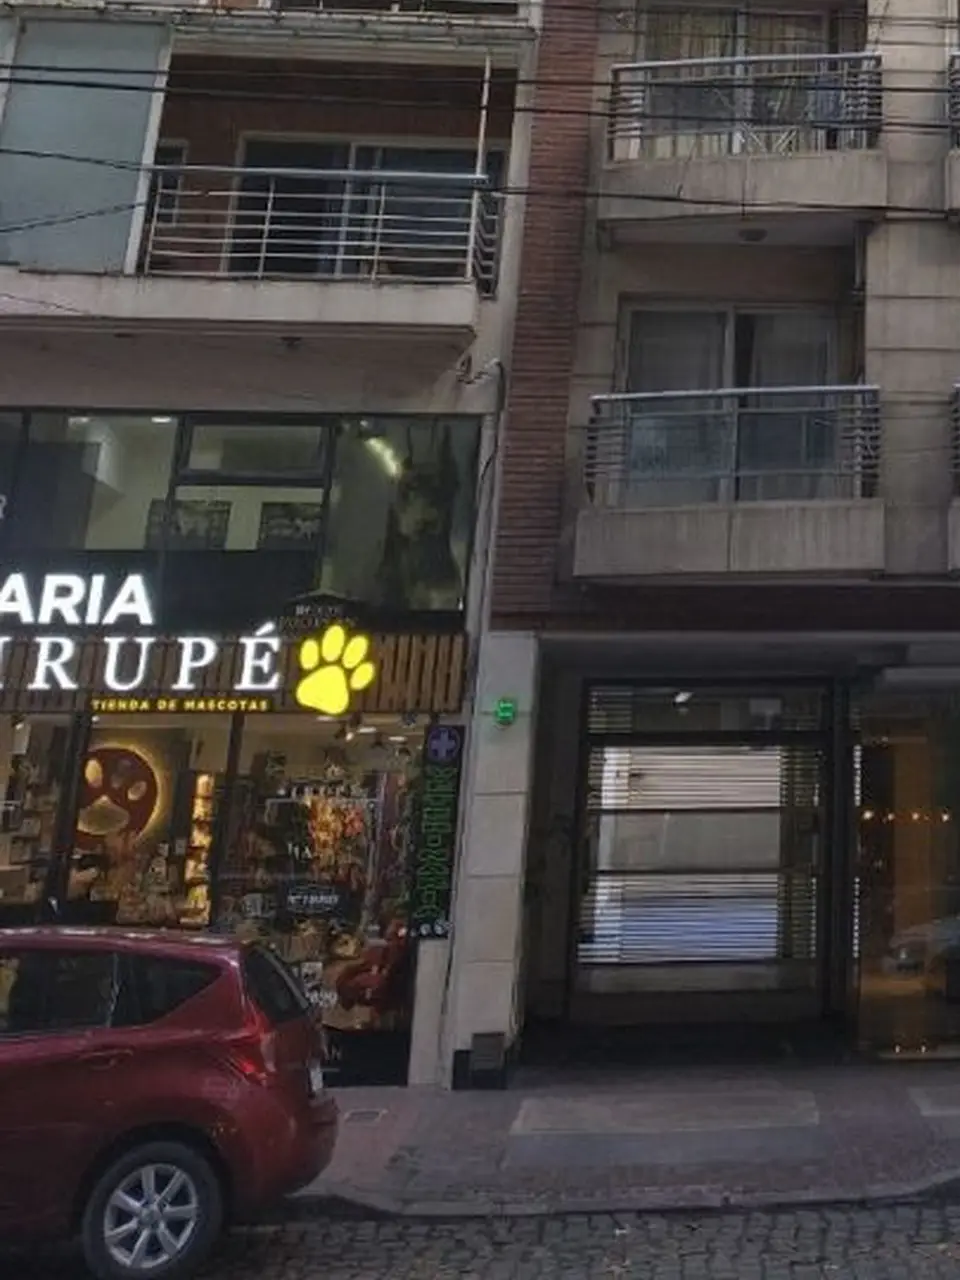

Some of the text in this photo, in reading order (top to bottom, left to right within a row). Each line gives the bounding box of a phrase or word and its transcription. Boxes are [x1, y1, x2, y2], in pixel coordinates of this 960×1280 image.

[0, 573, 154, 625] ARIA
[91, 699, 268, 711] TIENDA DE MASCOTAS
